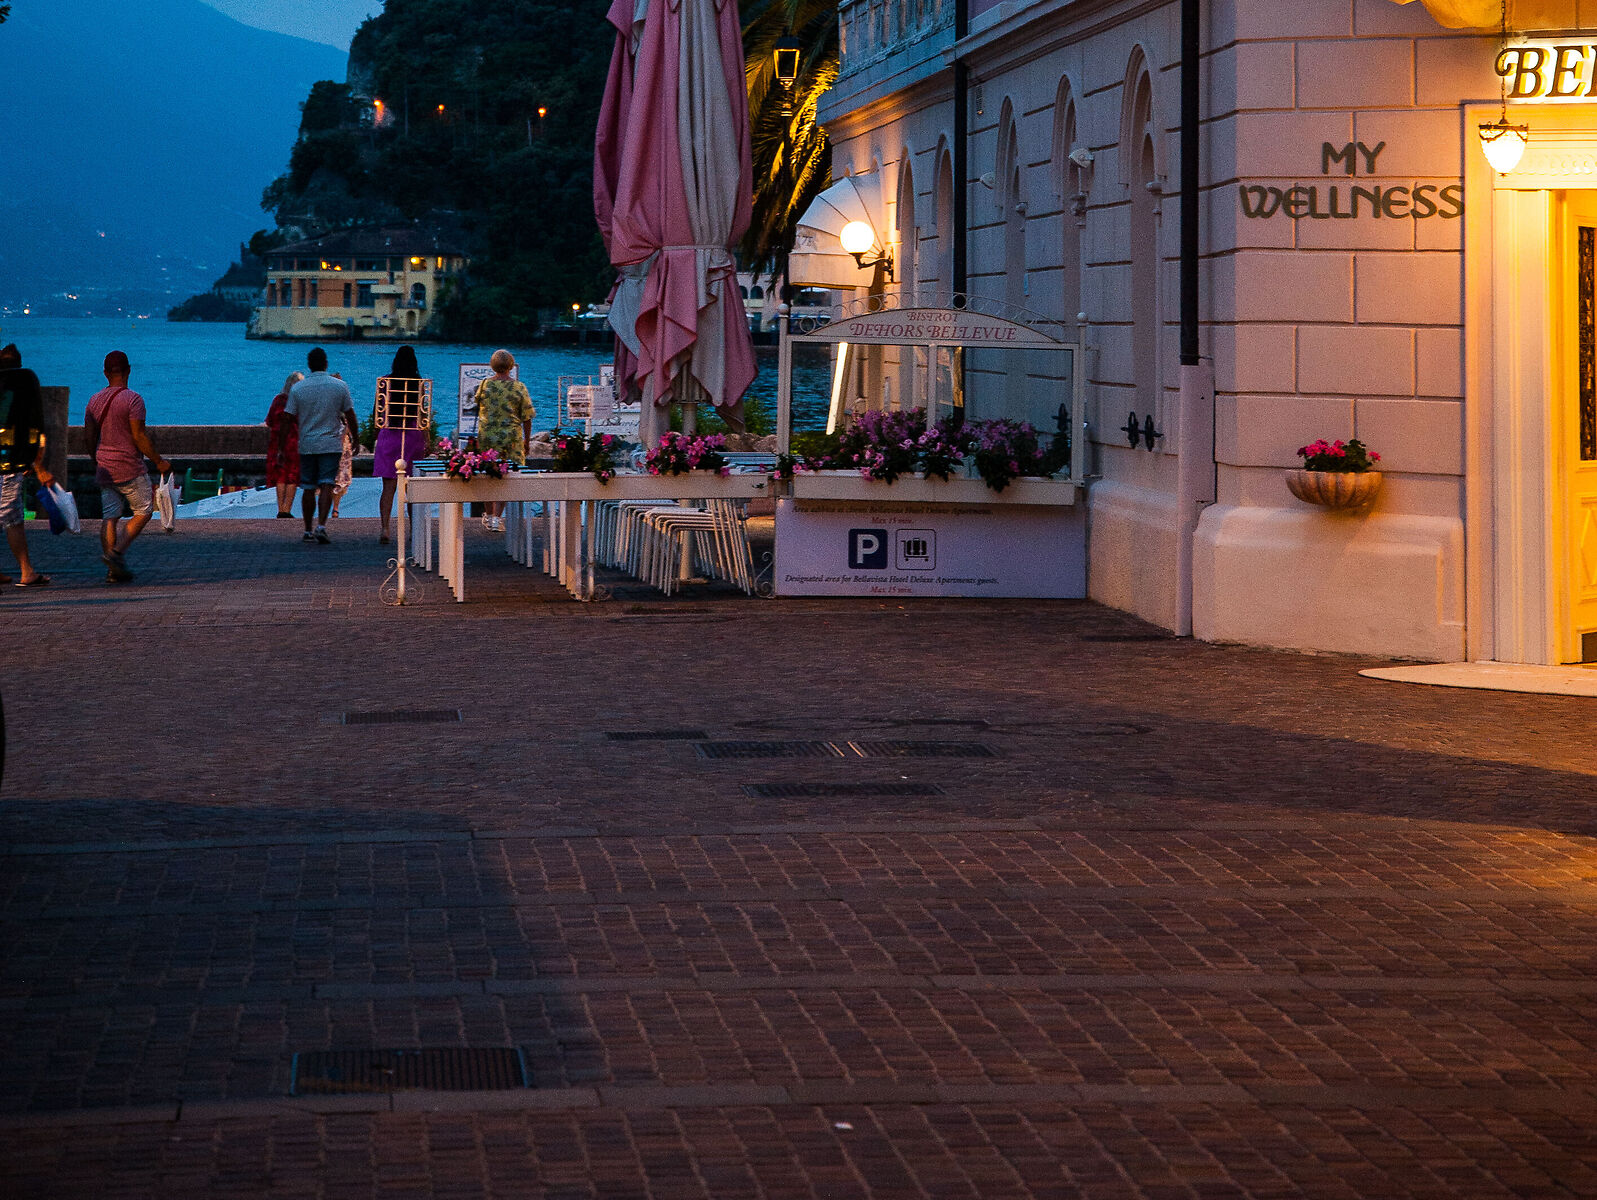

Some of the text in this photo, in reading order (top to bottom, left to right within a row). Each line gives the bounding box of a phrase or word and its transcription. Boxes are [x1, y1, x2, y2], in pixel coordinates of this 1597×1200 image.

[1321, 141, 1386, 176] MY
[1239, 184, 1465, 220] WELLNESS
[906, 311, 961, 323] BISTROT
[849, 323, 1017, 340] DEHORS BELLEVUE
[857, 534, 880, 564] P
[785, 574, 823, 584] Designated
[840, 574, 851, 584] for
[853, 575, 888, 583] Bellavista
[889, 575, 908, 583] Hotel
